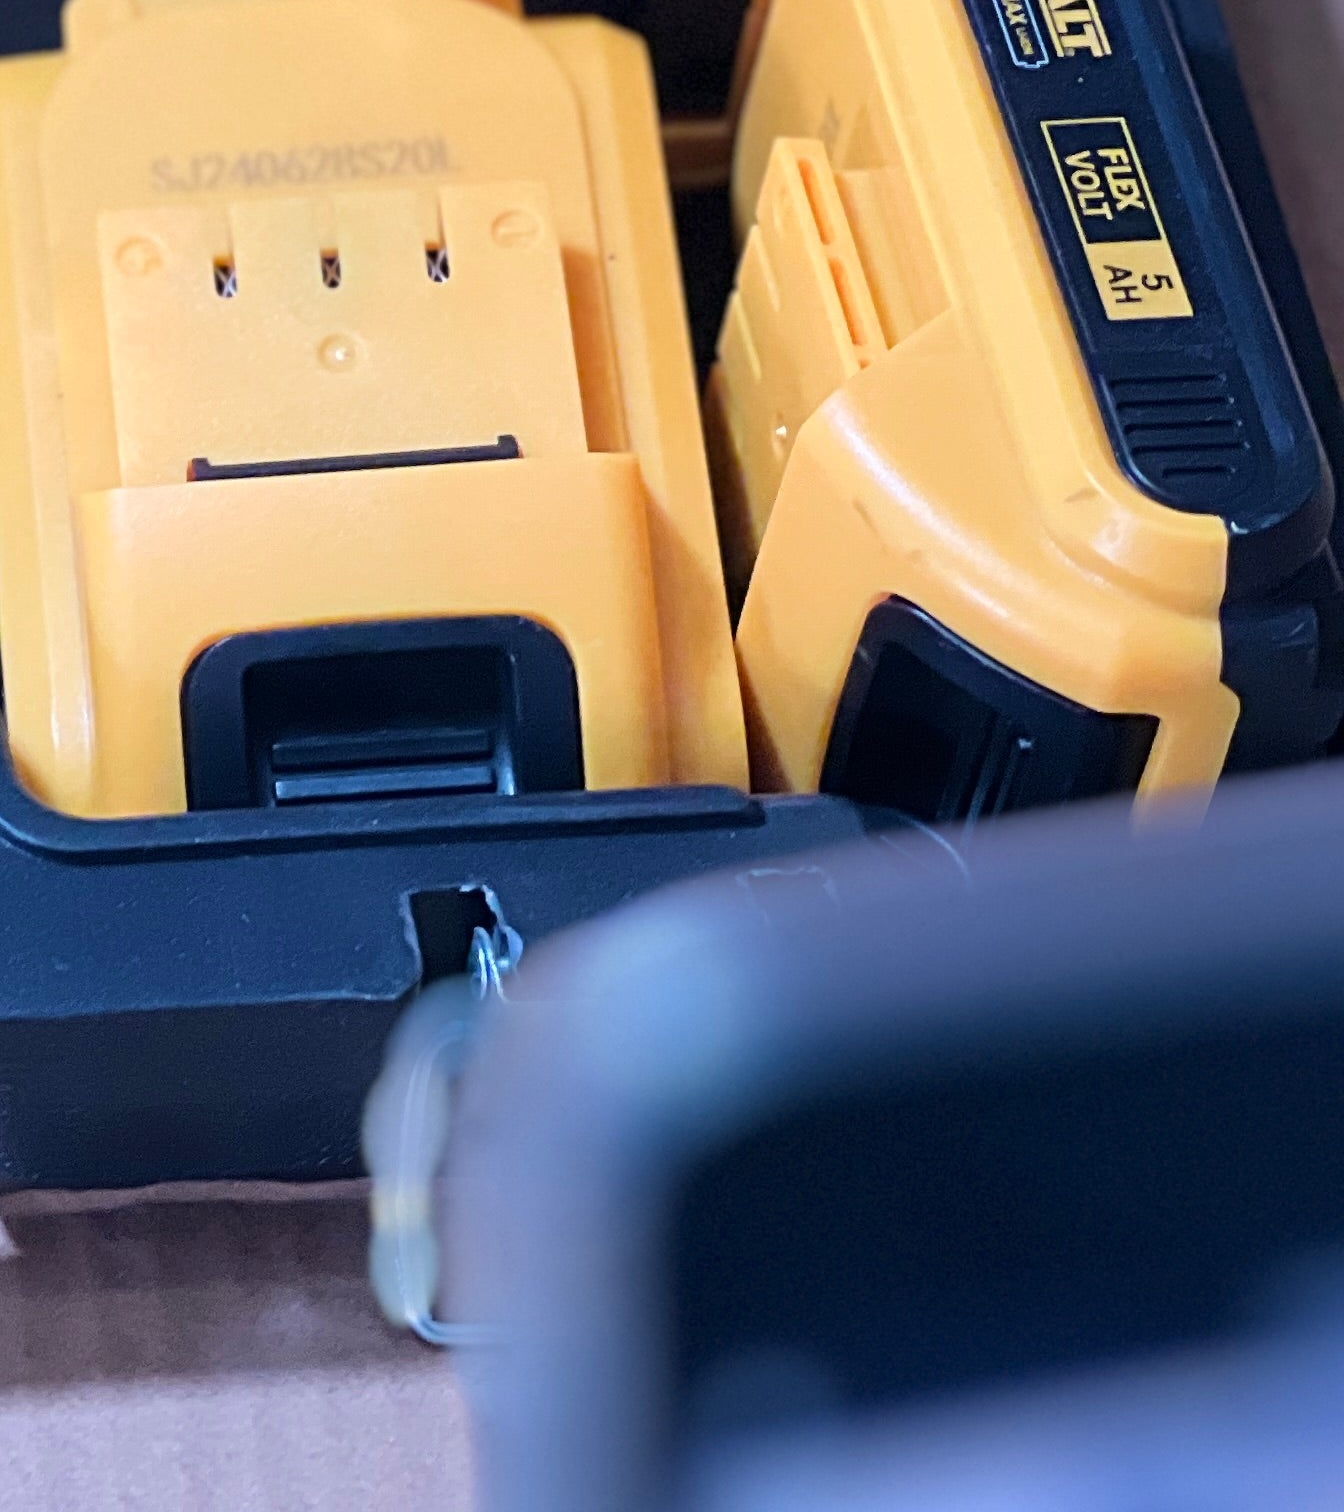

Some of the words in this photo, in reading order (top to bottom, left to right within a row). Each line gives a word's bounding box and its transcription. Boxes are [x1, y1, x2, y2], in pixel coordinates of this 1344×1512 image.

[1064, 149, 1114, 221] VOLT
[1096, 146, 1145, 212] FLEX
[1103, 264, 1143, 304] AH
[1141, 273, 1174, 291] 5
